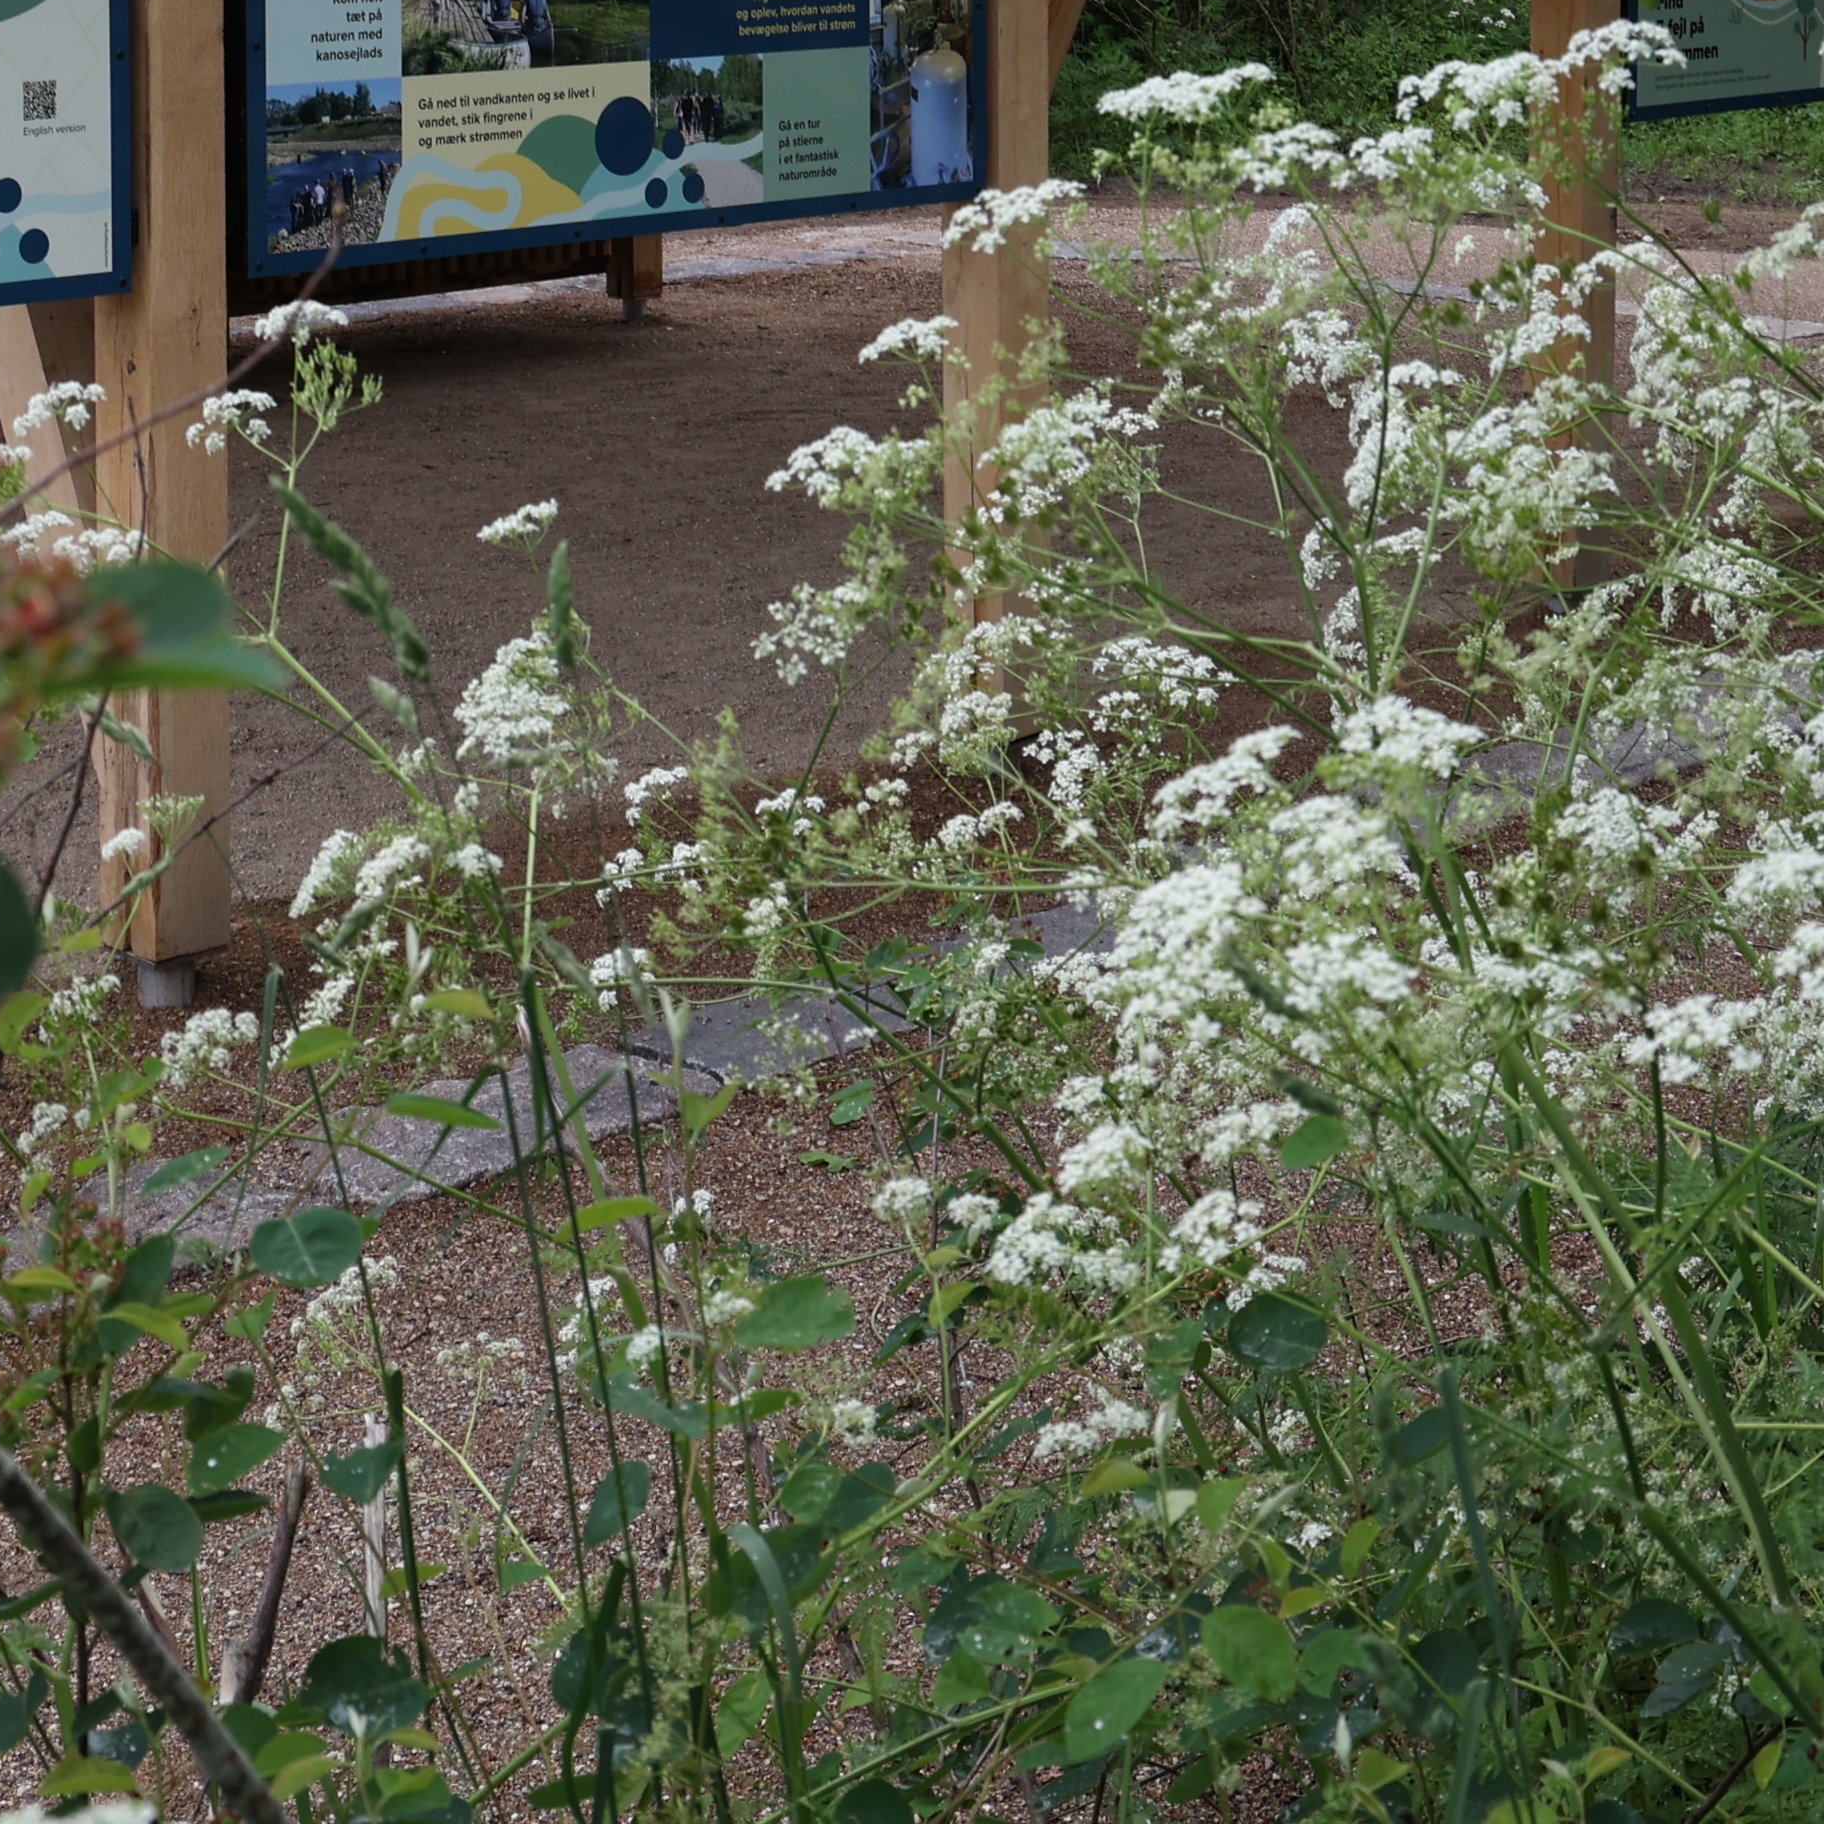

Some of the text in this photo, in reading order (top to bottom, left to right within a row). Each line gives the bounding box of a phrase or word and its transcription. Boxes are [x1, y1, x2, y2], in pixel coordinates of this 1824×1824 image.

[346, 8, 383, 24] tæt på
[736, 2, 856, 22] og oplev, hvordan vandets
[739, 19, 856, 37] bevægelse bliver til strøm
[1690, 15, 1705, 38] på
[311, 27, 383, 43] naturen med
[316, 46, 383, 62] kanosejlads
[418, 97, 434, 110] Gå
[436, 96, 457, 109] ned
[459, 95, 471, 107] til
[472, 92, 535, 106] vandkanten
[537, 91, 551, 104] og
[553, 90, 566, 101] se
[567, 87, 590, 100] livet
[418, 115, 459, 128] vandet,
[461, 113, 480, 126] stik
[483, 111, 527, 125] fingrene
[778, 119, 821, 131] Gå en tur
[23, 123, 86, 137] English version
[418, 128, 523, 149] og mærk strømmen
[778, 135, 824, 150] på stierne
[783, 154, 793, 165] et
[795, 149, 840, 163] fantastisk
[778, 165, 838, 182] naturområde
